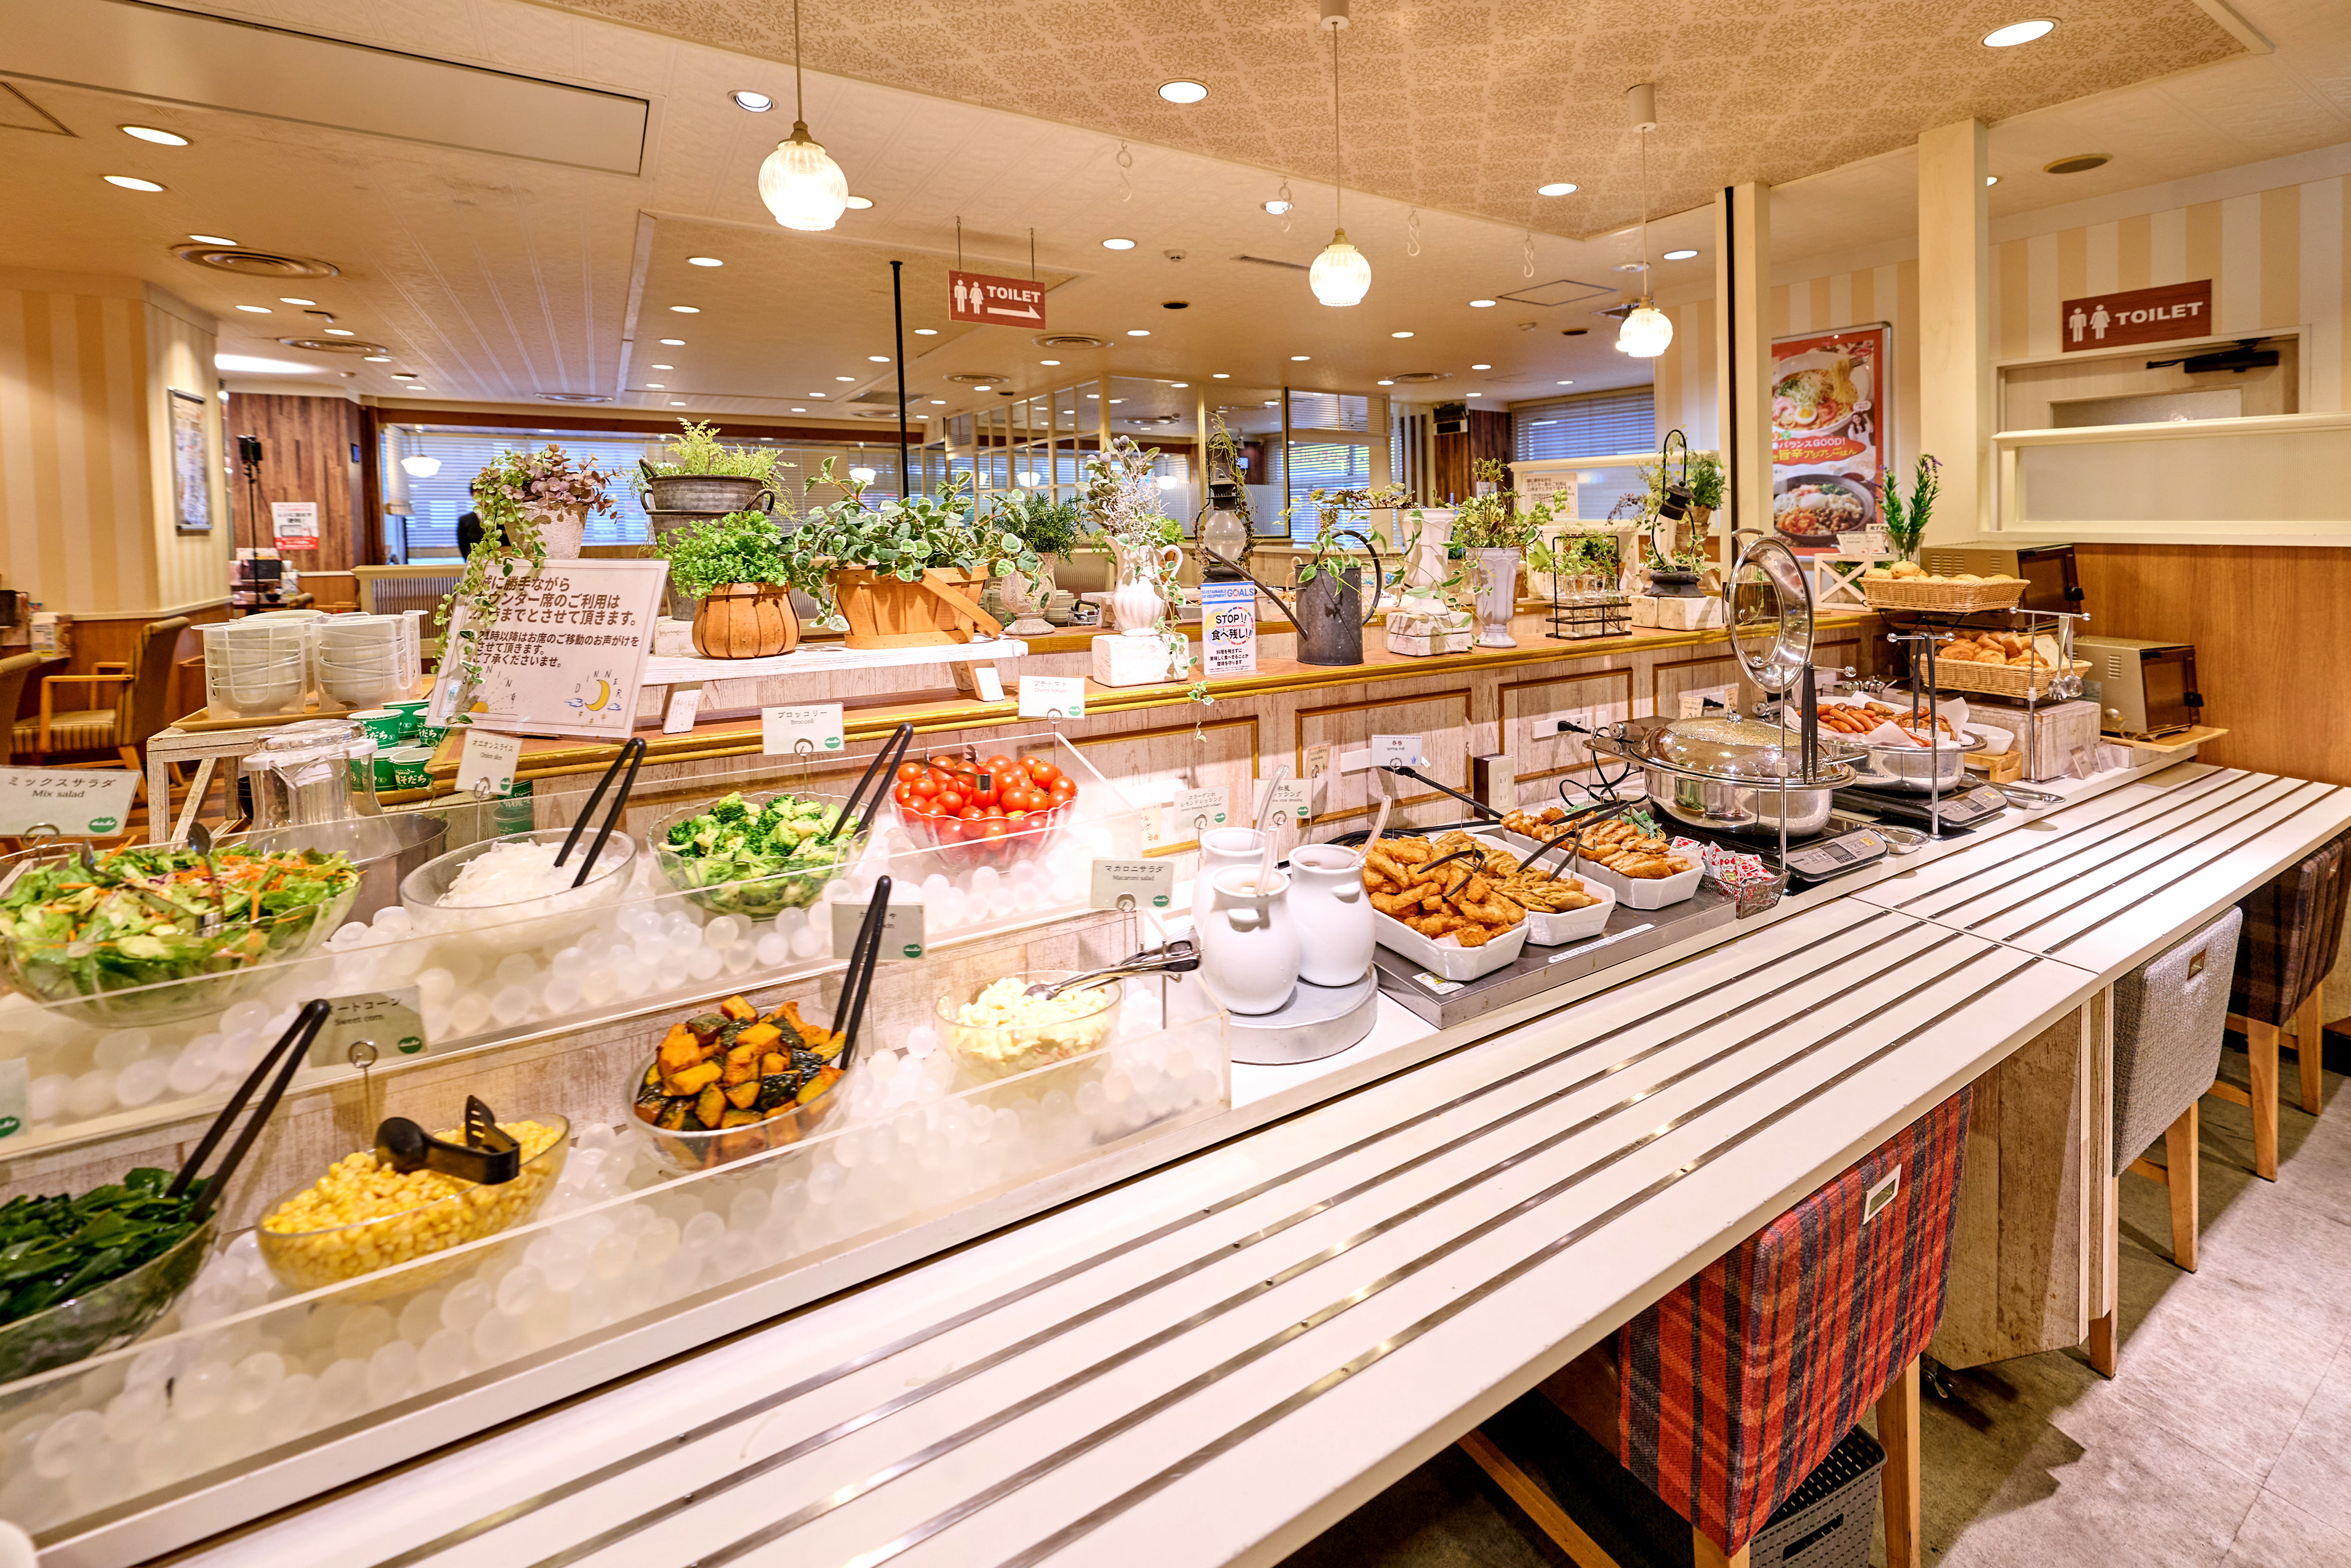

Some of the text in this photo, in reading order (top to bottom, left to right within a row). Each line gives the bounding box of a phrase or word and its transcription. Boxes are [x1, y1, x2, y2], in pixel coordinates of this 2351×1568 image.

[986, 285, 1040, 303] TOILET
[2115, 301, 2203, 325] TOILET
[1227, 588, 1254, 597] GOALS
[477, 630, 639, 647] 21時以降はお席のご移動のお声がけを
[1212, 628, 1252, 640] 食べ残し!!
[477, 642, 545, 656] させて頂きます。
[472, 652, 562, 668] ご了承くださいませ。
[575, 668, 622, 699] DINNER
[778, 710, 828, 718] ブロッコリー
[472, 740, 513, 752] オニオンスライス
[9, 777, 116, 788] ミックスサラダ
[1181, 796, 1223, 807] レモンドレッシング
[330, 999, 401, 1015] ートコーン
[333, 1014, 384, 1026] Sweet corn
